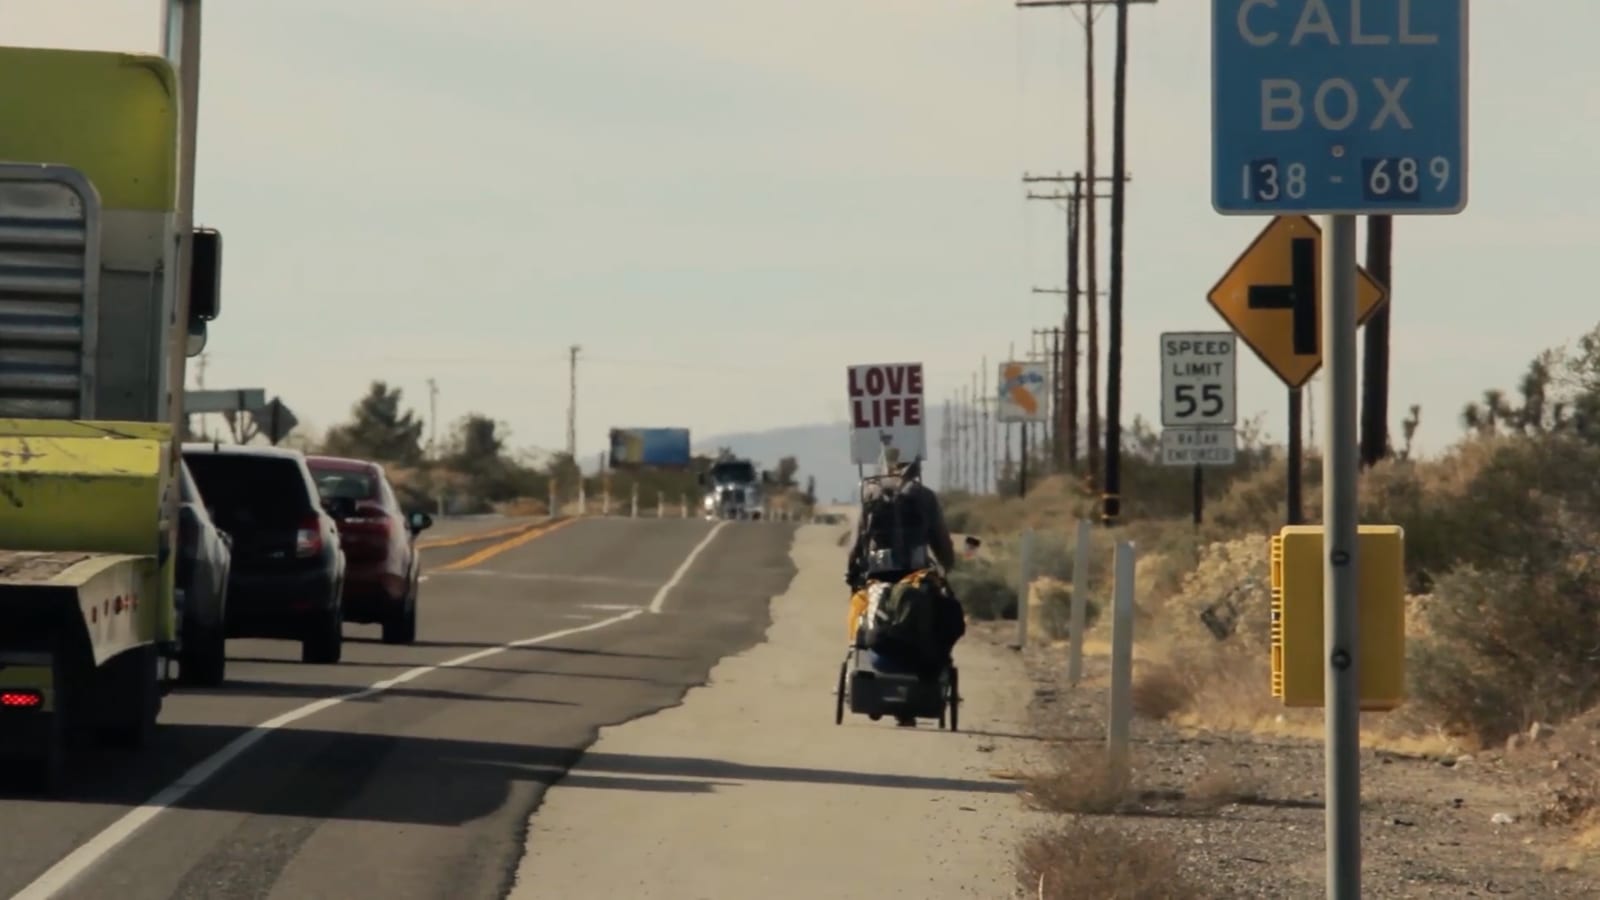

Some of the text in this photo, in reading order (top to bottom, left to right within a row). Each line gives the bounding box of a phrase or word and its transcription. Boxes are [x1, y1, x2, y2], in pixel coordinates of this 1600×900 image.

[1236, 0, 1438, 46] CALL
[1260, 77, 1413, 131] BOX
[1241, 162, 1306, 200] 138
[1369, 156, 1451, 195] 689
[1166, 340, 1231, 356] SPEED
[848, 364, 923, 398] LOVE
[1173, 361, 1223, 377] LIMIT
[853, 398, 921, 429] LIFE
[1174, 383, 1224, 418] 55
